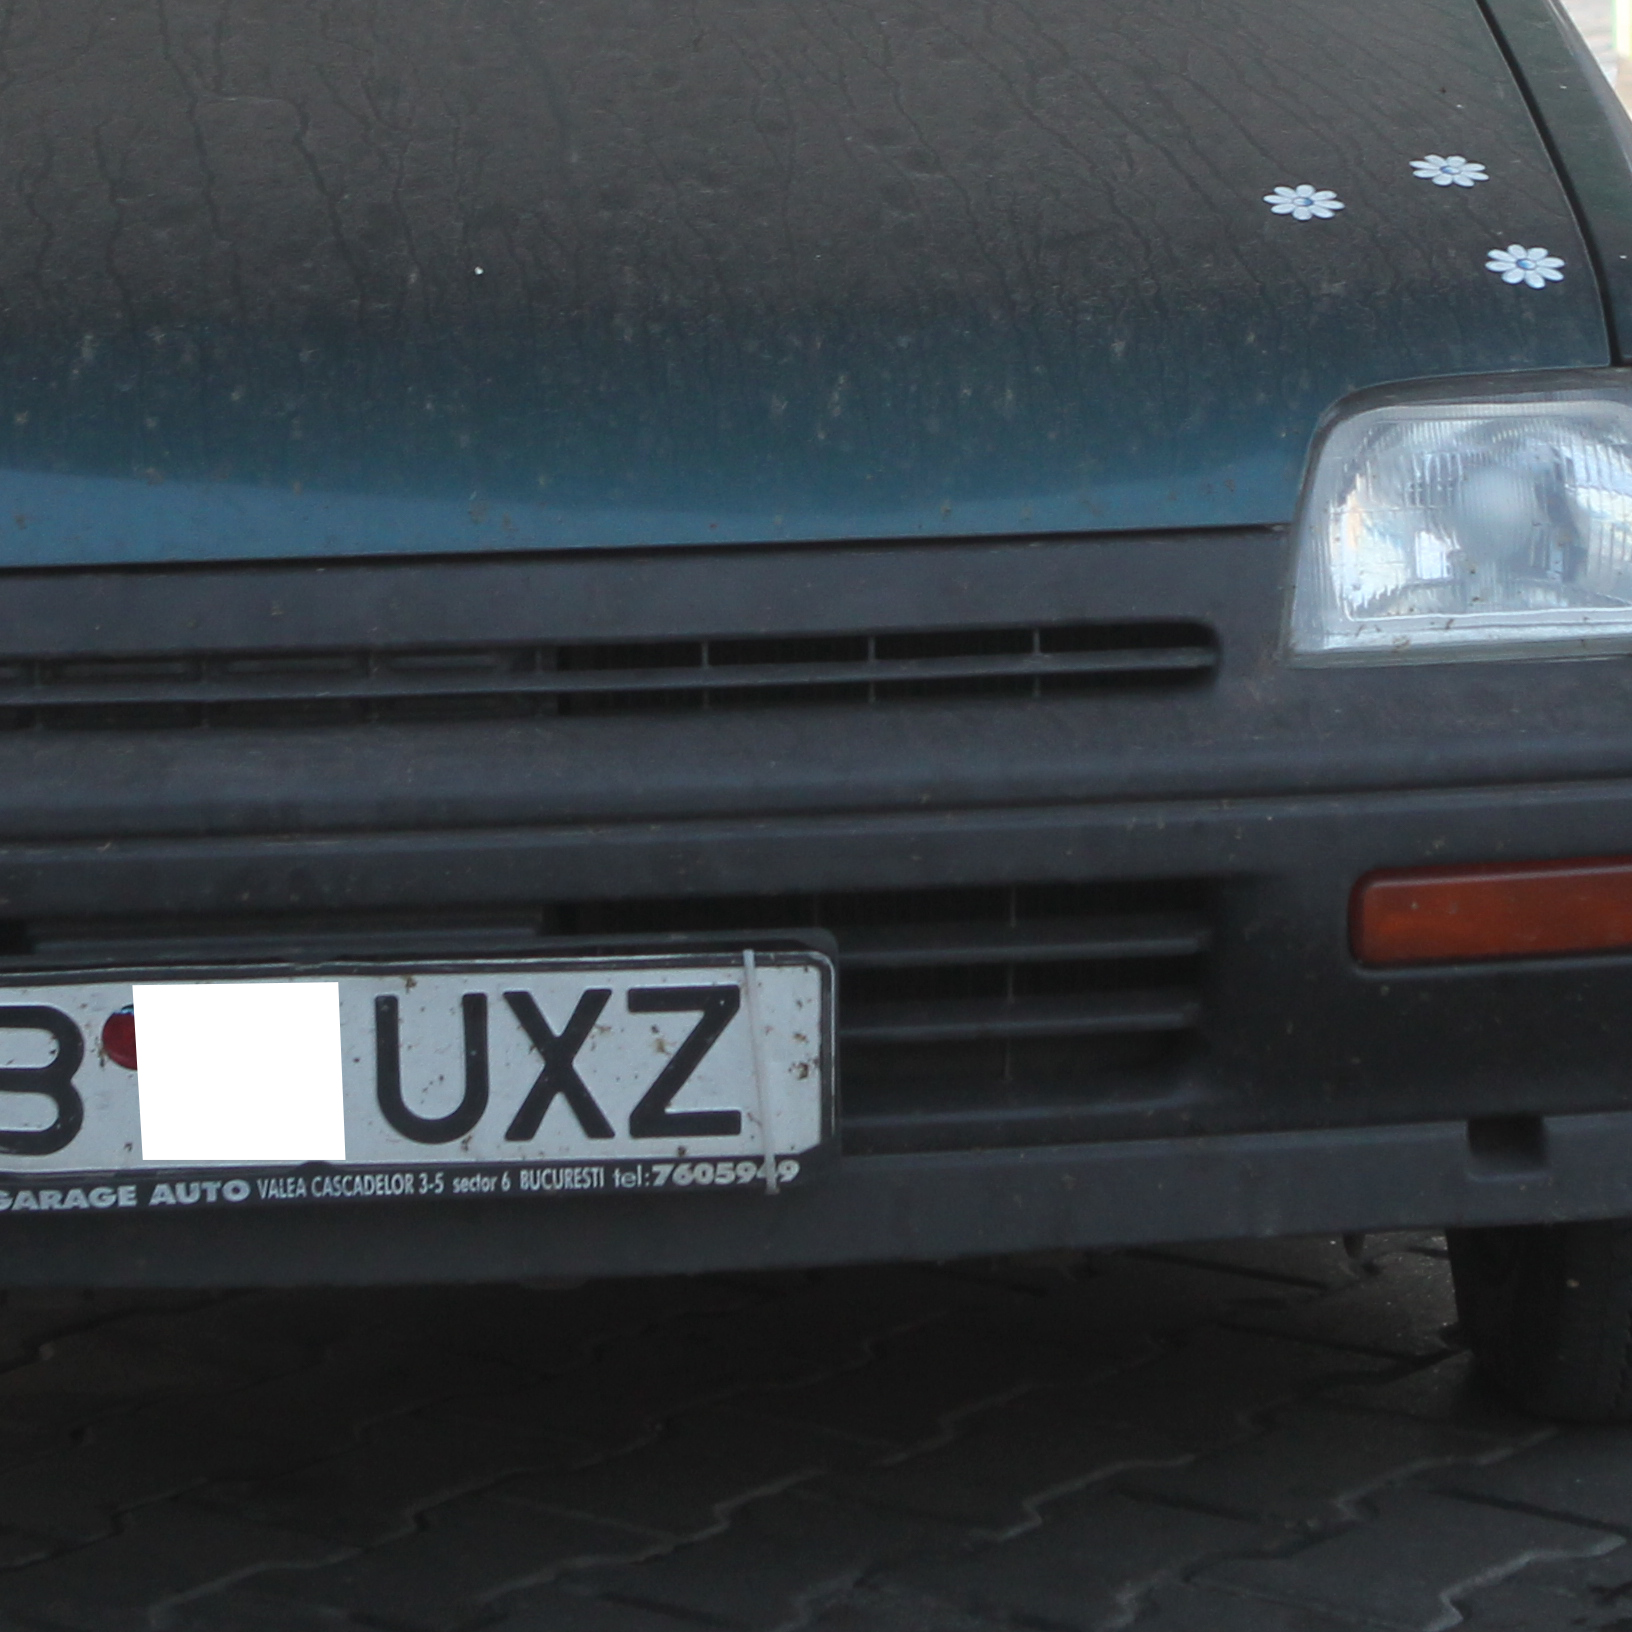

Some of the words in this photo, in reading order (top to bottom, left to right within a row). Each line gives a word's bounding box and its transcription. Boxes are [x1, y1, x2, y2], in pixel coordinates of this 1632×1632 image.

[374, 984, 742, 1144] UXZ
[149, 1178, 250, 1206] AUTO
[256, 1176, 307, 1200] VALEA
[311, 1172, 413, 1197] CASCADELOR
[418, 1171, 444, 1194] 3-5
[452, 1171, 498, 1193] sector
[501, 1171, 511, 1192] 6
[520, 1166, 605, 1191] BUCURESTI
